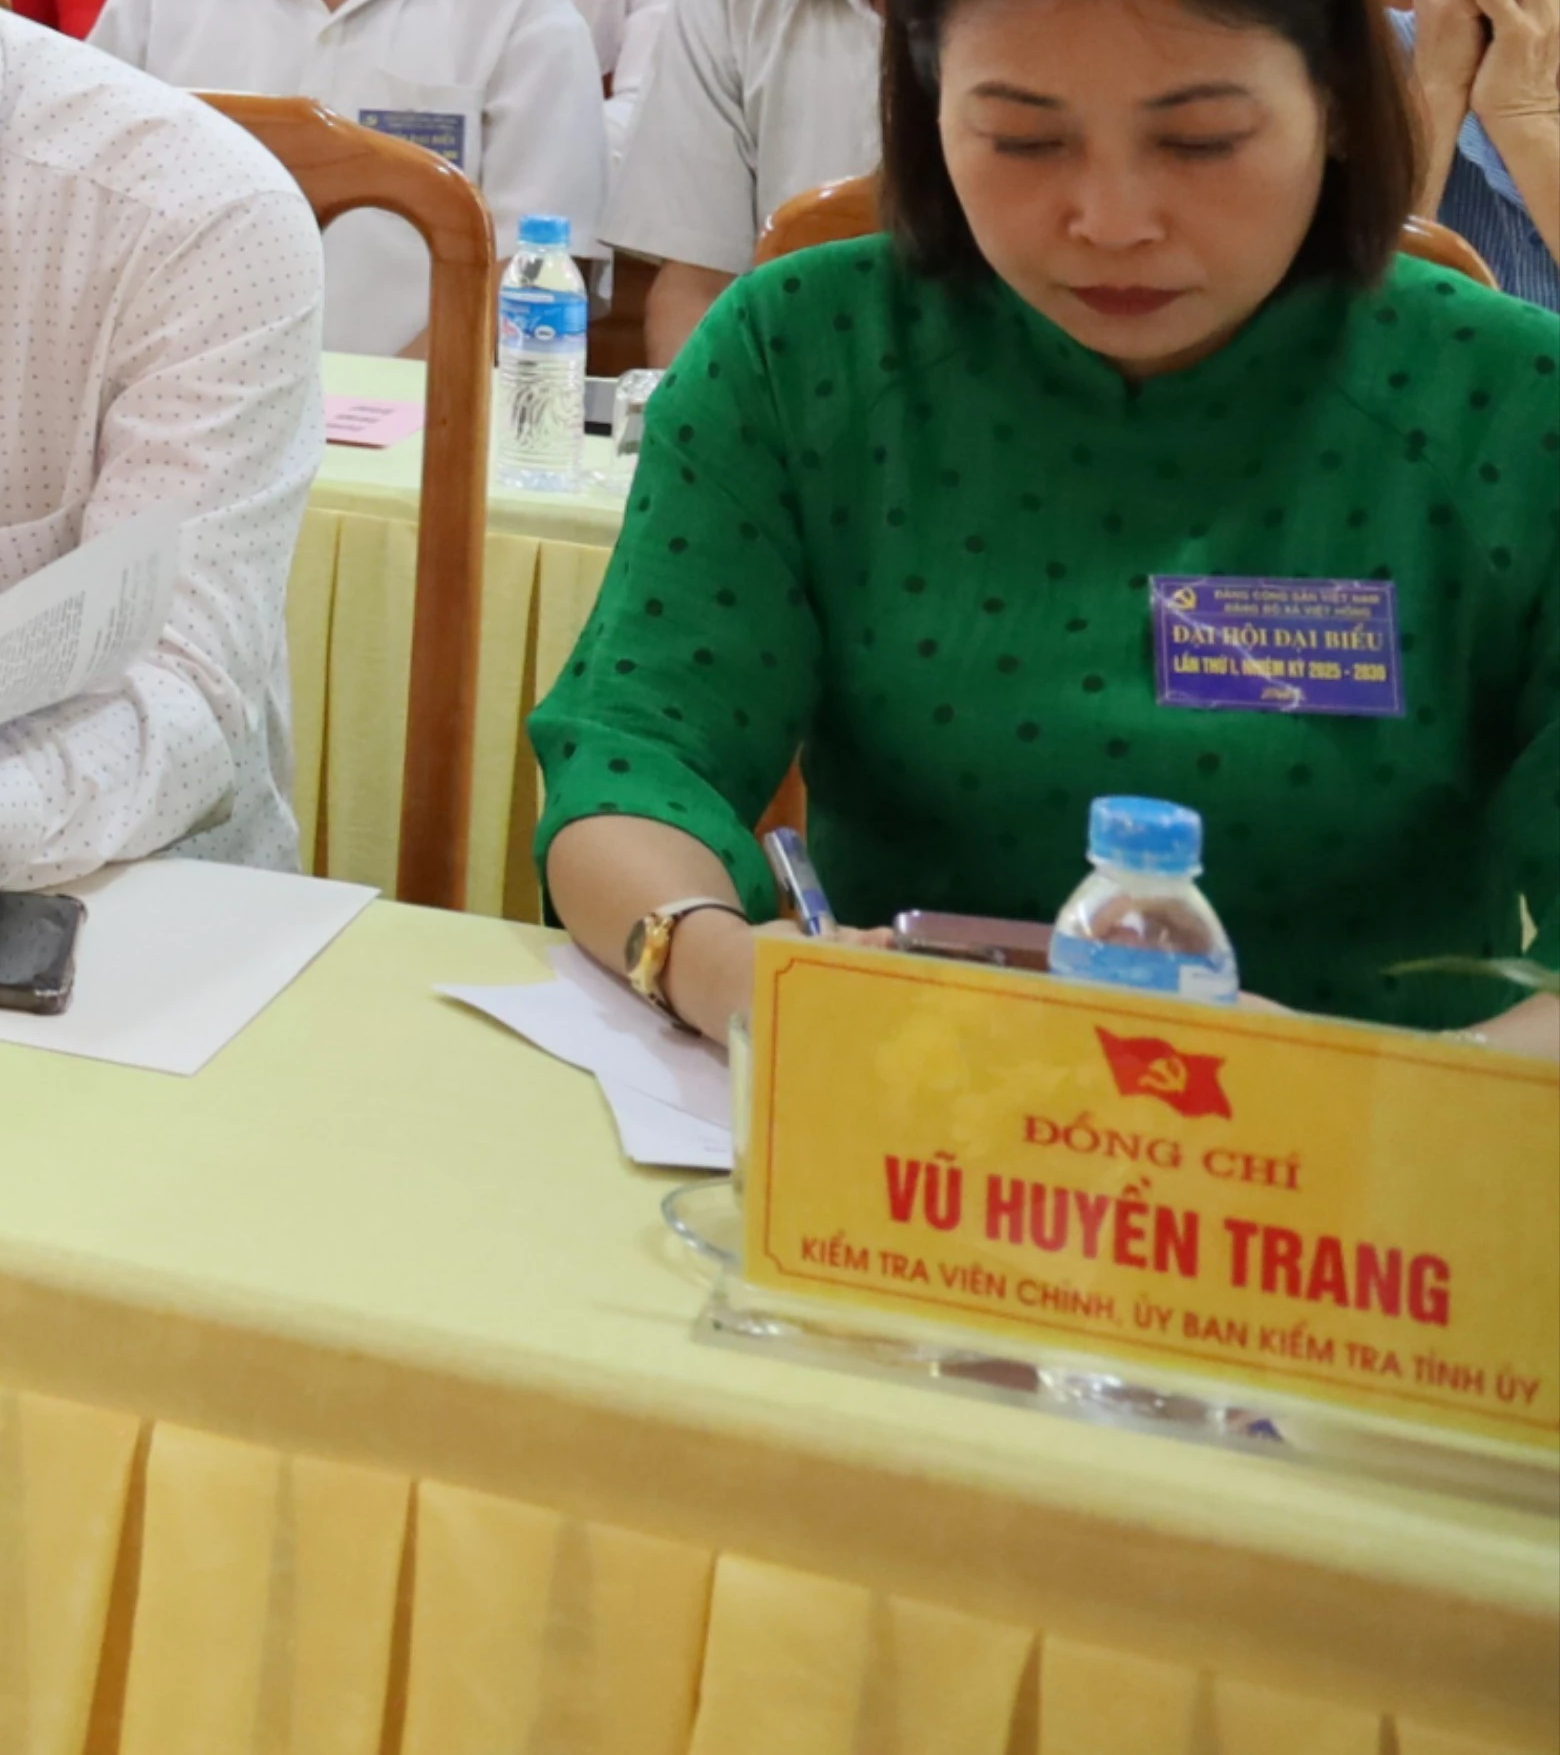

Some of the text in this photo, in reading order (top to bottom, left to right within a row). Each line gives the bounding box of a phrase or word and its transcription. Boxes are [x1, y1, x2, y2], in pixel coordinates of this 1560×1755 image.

[1173, 621, 1383, 653] ĐẠI HỘI ĐẠI BIỂU
[1288, 656, 1306, 678] KỲ
[1022, 1110, 1305, 1192] ĐỒNG CHÍ
[883, 1150, 1452, 1327] VŨ HUYỀN TRANG
[801, 1227, 869, 1273] KIỂM
[877, 1249, 930, 1285] TRA
[937, 1262, 1007, 1299] VIÊN
[1133, 1292, 1175, 1333] ỦY
[1183, 1311, 1248, 1349] BAN
[1258, 1317, 1335, 1365] KIỂM
[1345, 1342, 1404, 1378] TRA
[1410, 1350, 1485, 1393] TỈNH
[1495, 1361, 1542, 1406] ỦY
